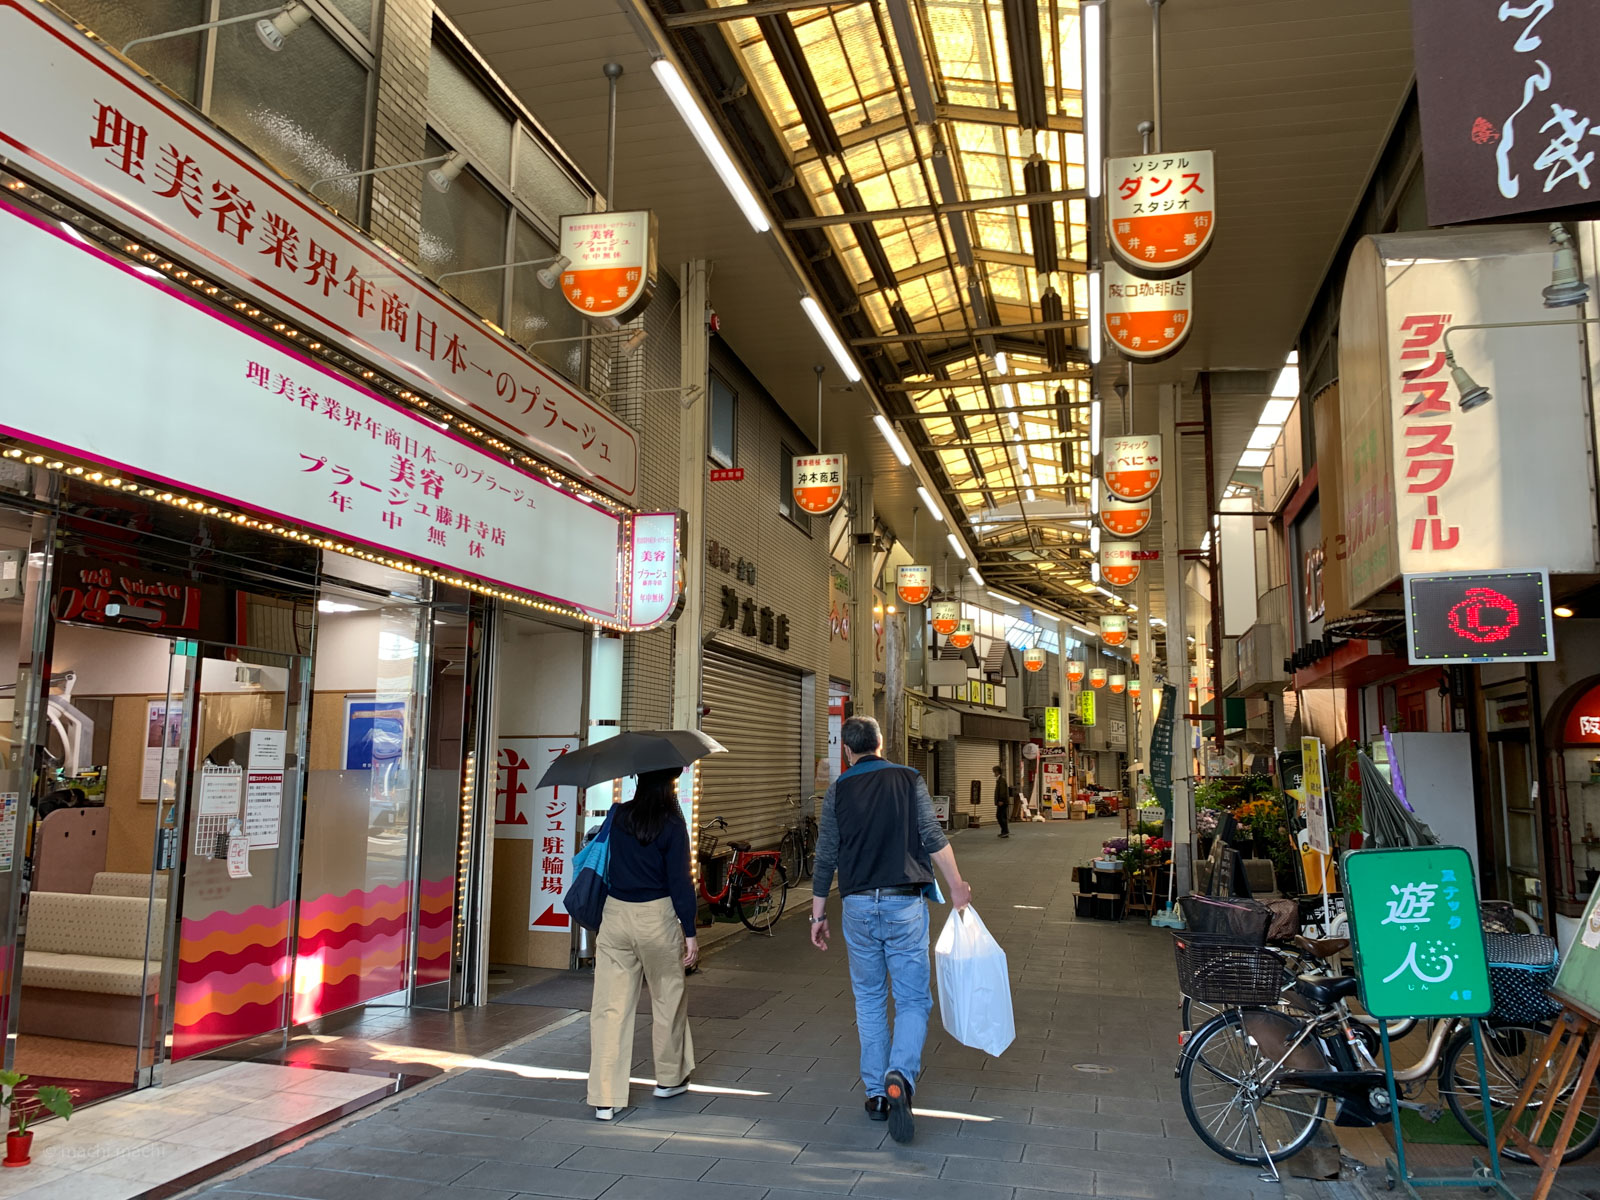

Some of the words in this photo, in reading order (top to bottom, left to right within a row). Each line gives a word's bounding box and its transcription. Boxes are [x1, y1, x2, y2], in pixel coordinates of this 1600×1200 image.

[1118, 172, 1205, 201] ダンス
[1133, 158, 1190, 172] ソシアル
[1133, 199, 1191, 214] スタジオ
[1117, 216, 1209, 259] 藤井寺一番街
[90, 98, 611, 463] 理美容業界年商日本一のプラージュ
[245, 360, 537, 510] 理美容業界年商日本一のプラージュ
[1400, 313, 1460, 551] ダンススクール
[389, 453, 445, 500] 美容
[798, 471, 839, 485] 沖本商店
[641, 550, 666, 562] 美容
[540, 743, 572, 896] プージュ駐輪場
